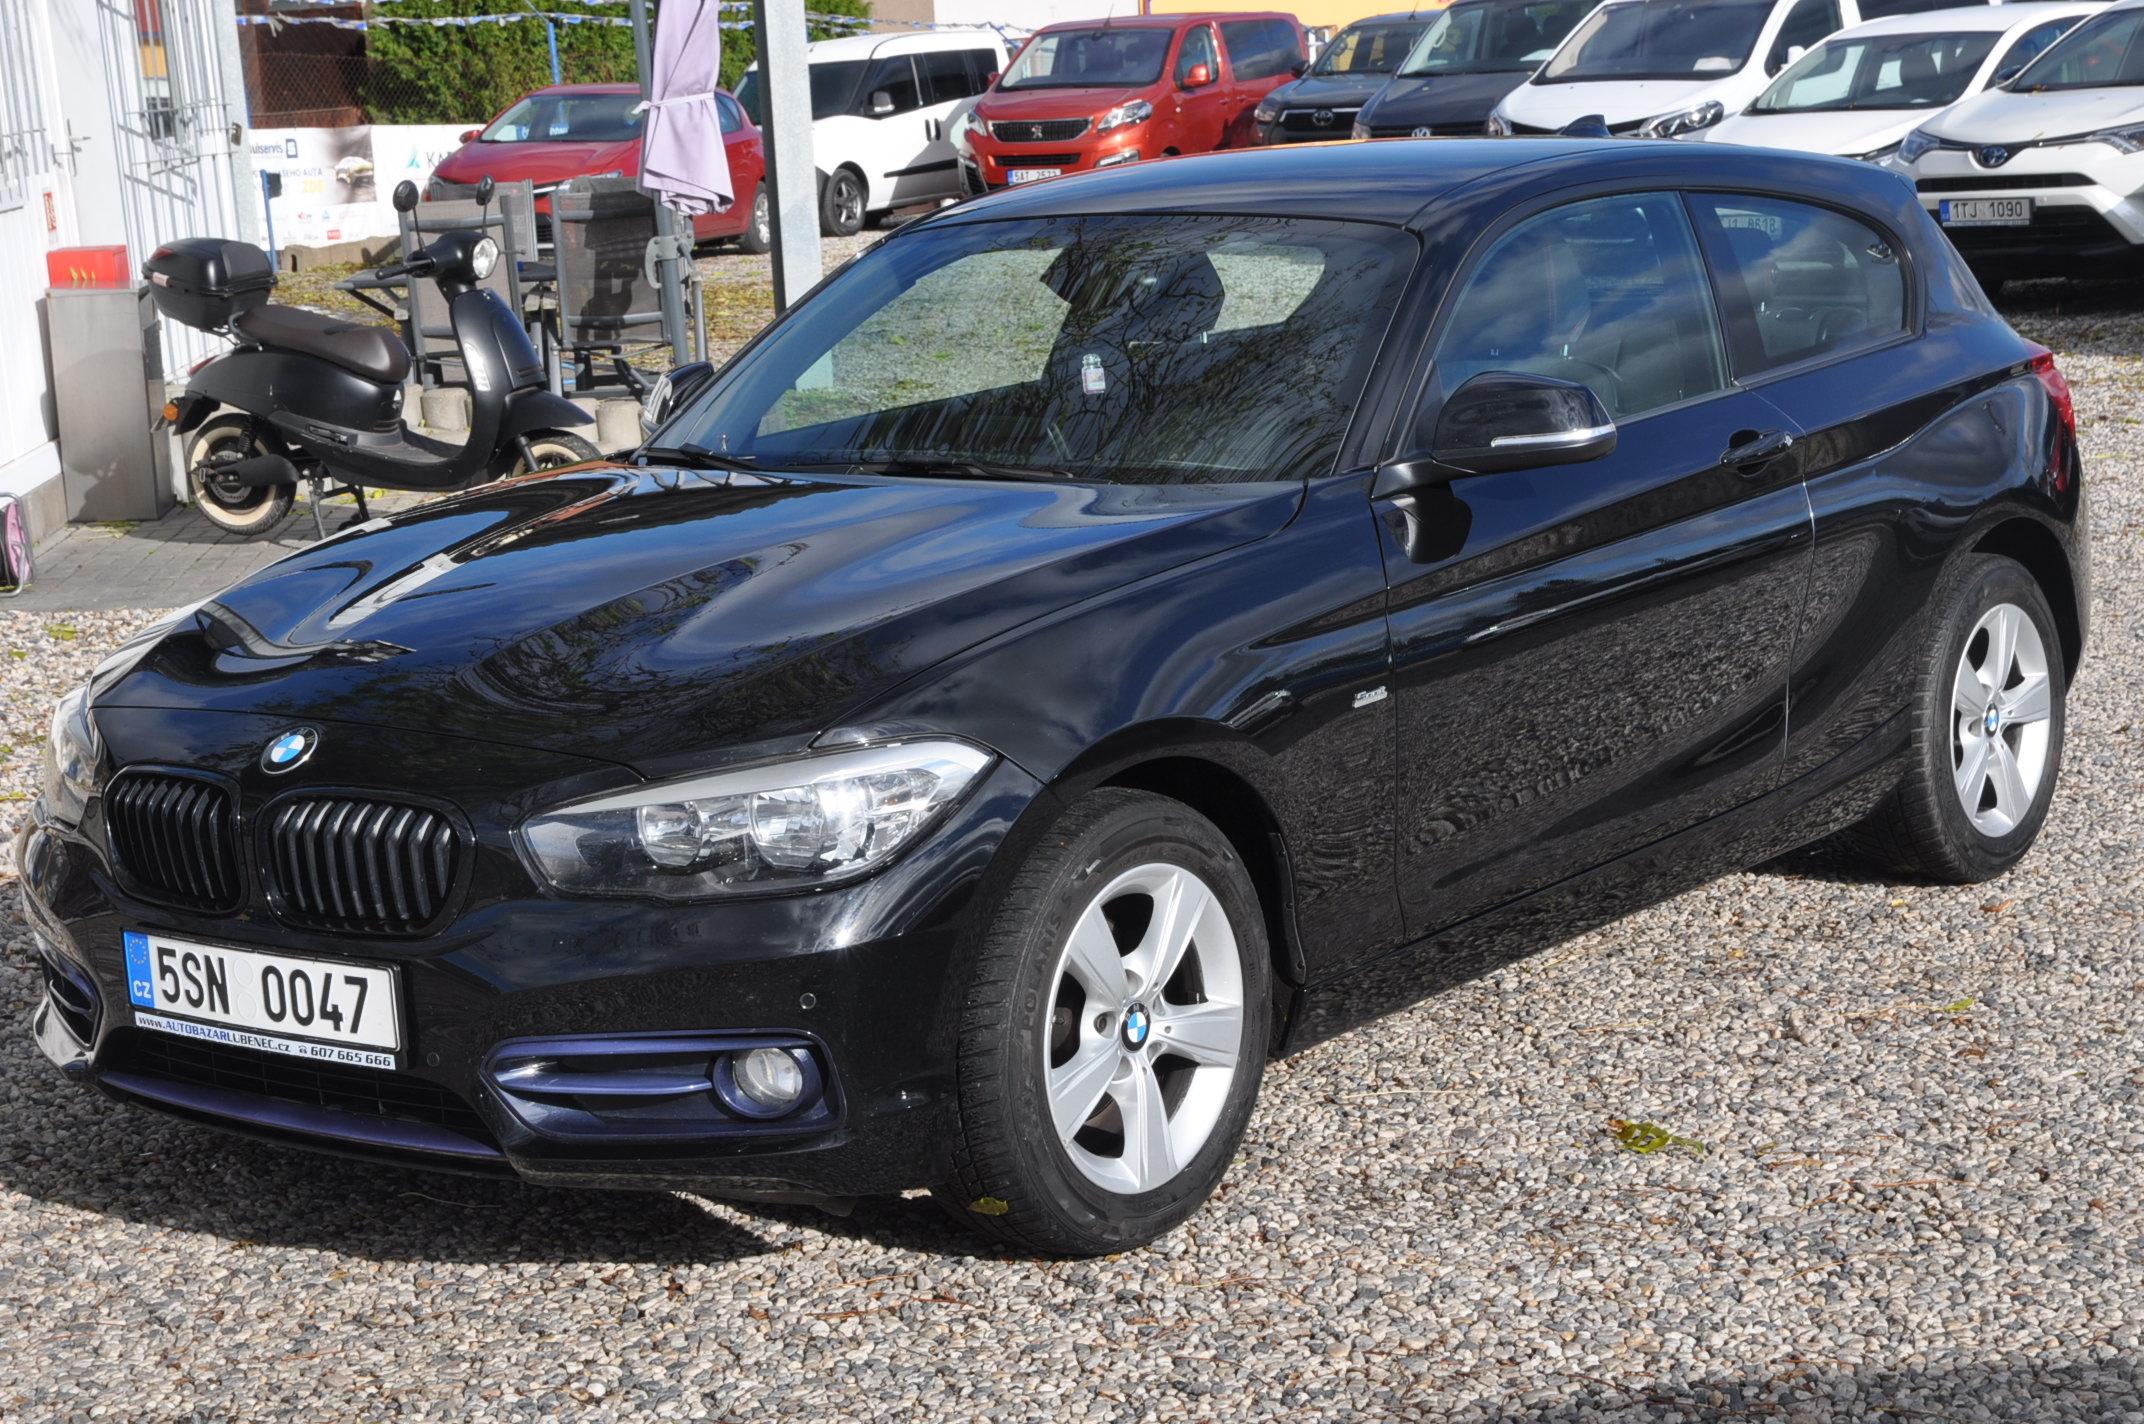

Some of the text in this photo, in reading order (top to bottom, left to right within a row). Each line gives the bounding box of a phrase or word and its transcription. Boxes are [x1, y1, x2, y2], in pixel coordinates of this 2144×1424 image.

[1953, 202, 1978, 218] 1TJ
[1989, 201, 2023, 218] 1090
[133, 979, 152, 999] CZ
[157, 946, 369, 1034] 5SN 0047
[310, 1046, 335, 1059] 607
[337, 1050, 362, 1063] 665
[365, 1054, 391, 1067] 666
